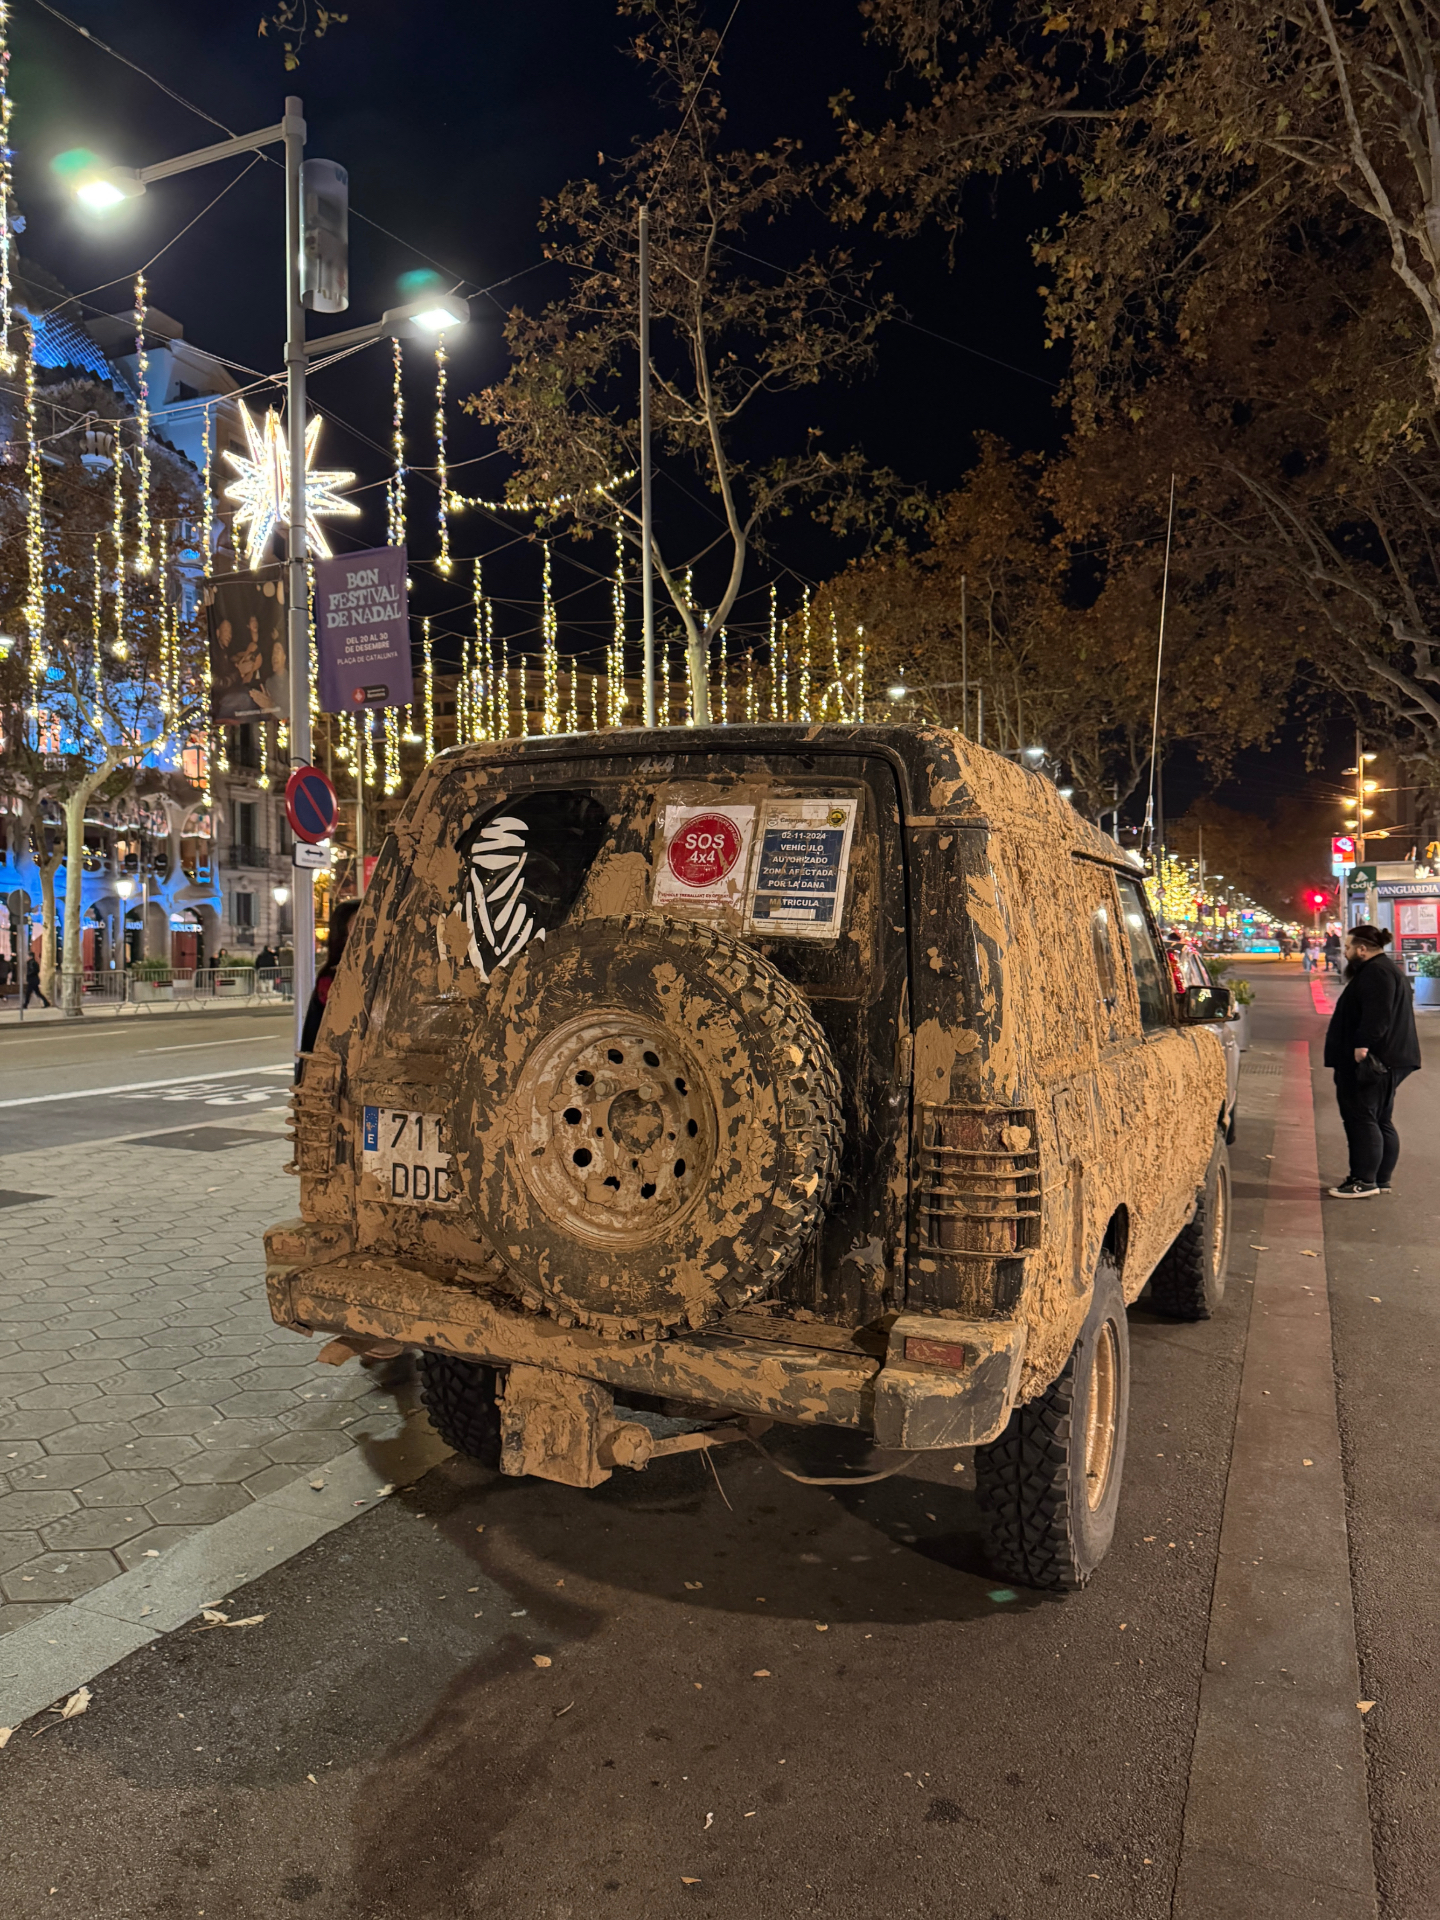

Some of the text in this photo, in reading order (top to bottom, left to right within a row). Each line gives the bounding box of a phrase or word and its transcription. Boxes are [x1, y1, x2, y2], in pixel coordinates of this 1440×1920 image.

[346, 568, 379, 589] BON
[328, 584, 400, 611] FESTIVAL
[326, 602, 402, 629] DE NADAL
[346, 632, 388, 645] DEL 20 AL 30
[345, 640, 390, 653] DE DESEMBRE
[337, 657, 356, 666] PLAÇA
[366, 651, 398, 662] CATALUNYA
[685, 833, 725, 850] SOS
[781, 832, 827, 840] 02-11-2024
[780, 842, 824, 852] VEHÍCULO
[690, 850, 715, 863] 4x4
[772, 856, 828, 864] AUTORIZADO
[788, 868, 834, 877] AFECTADA
[768, 880, 786, 888] POR
[801, 881, 825, 889] DANA
[1377, 884, 1439, 895] VANGUARDIA
[769, 898, 820, 908] MATRICULA
[367, 1134, 375, 1144] E
